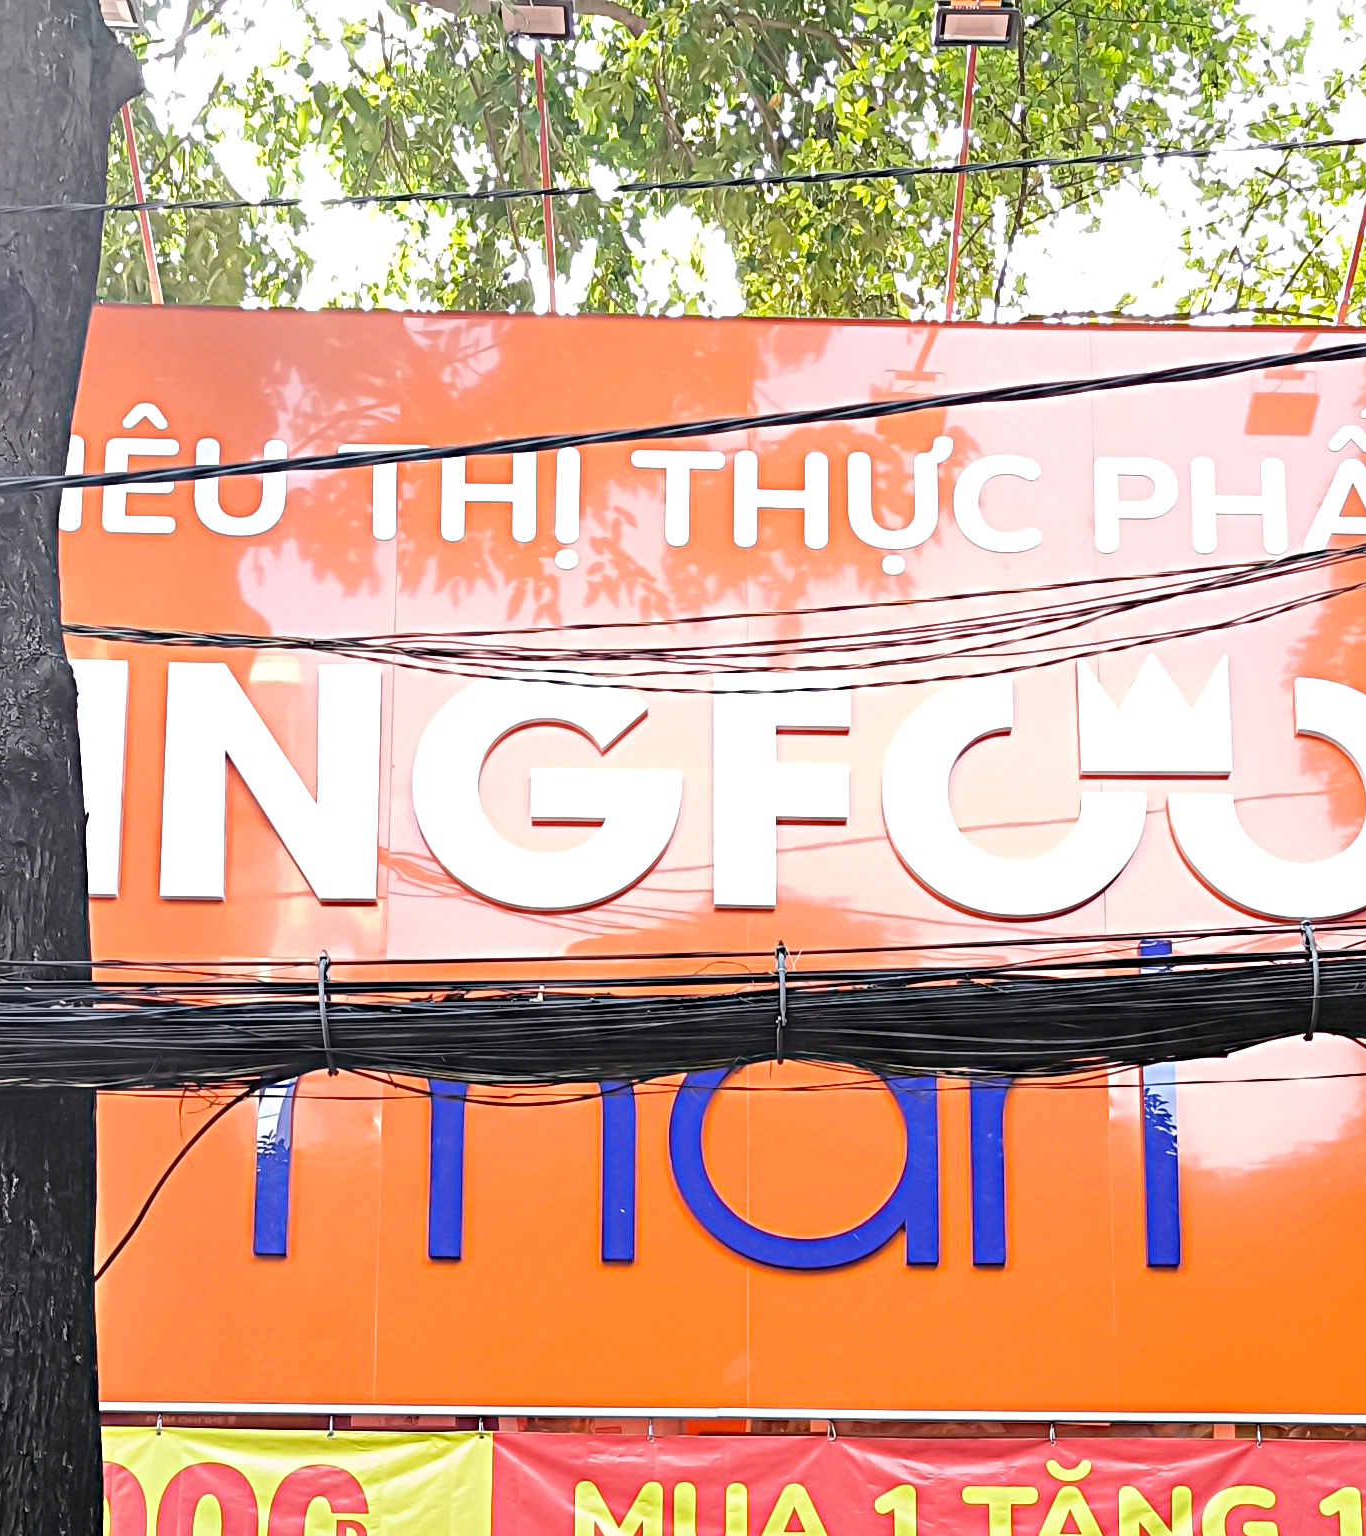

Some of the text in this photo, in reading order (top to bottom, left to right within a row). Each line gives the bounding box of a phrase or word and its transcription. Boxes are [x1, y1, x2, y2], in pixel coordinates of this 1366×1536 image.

[58, 402, 287, 536] IÊU
[336, 442, 581, 570] THỊ
[632, 435, 1043, 577] THỰC
